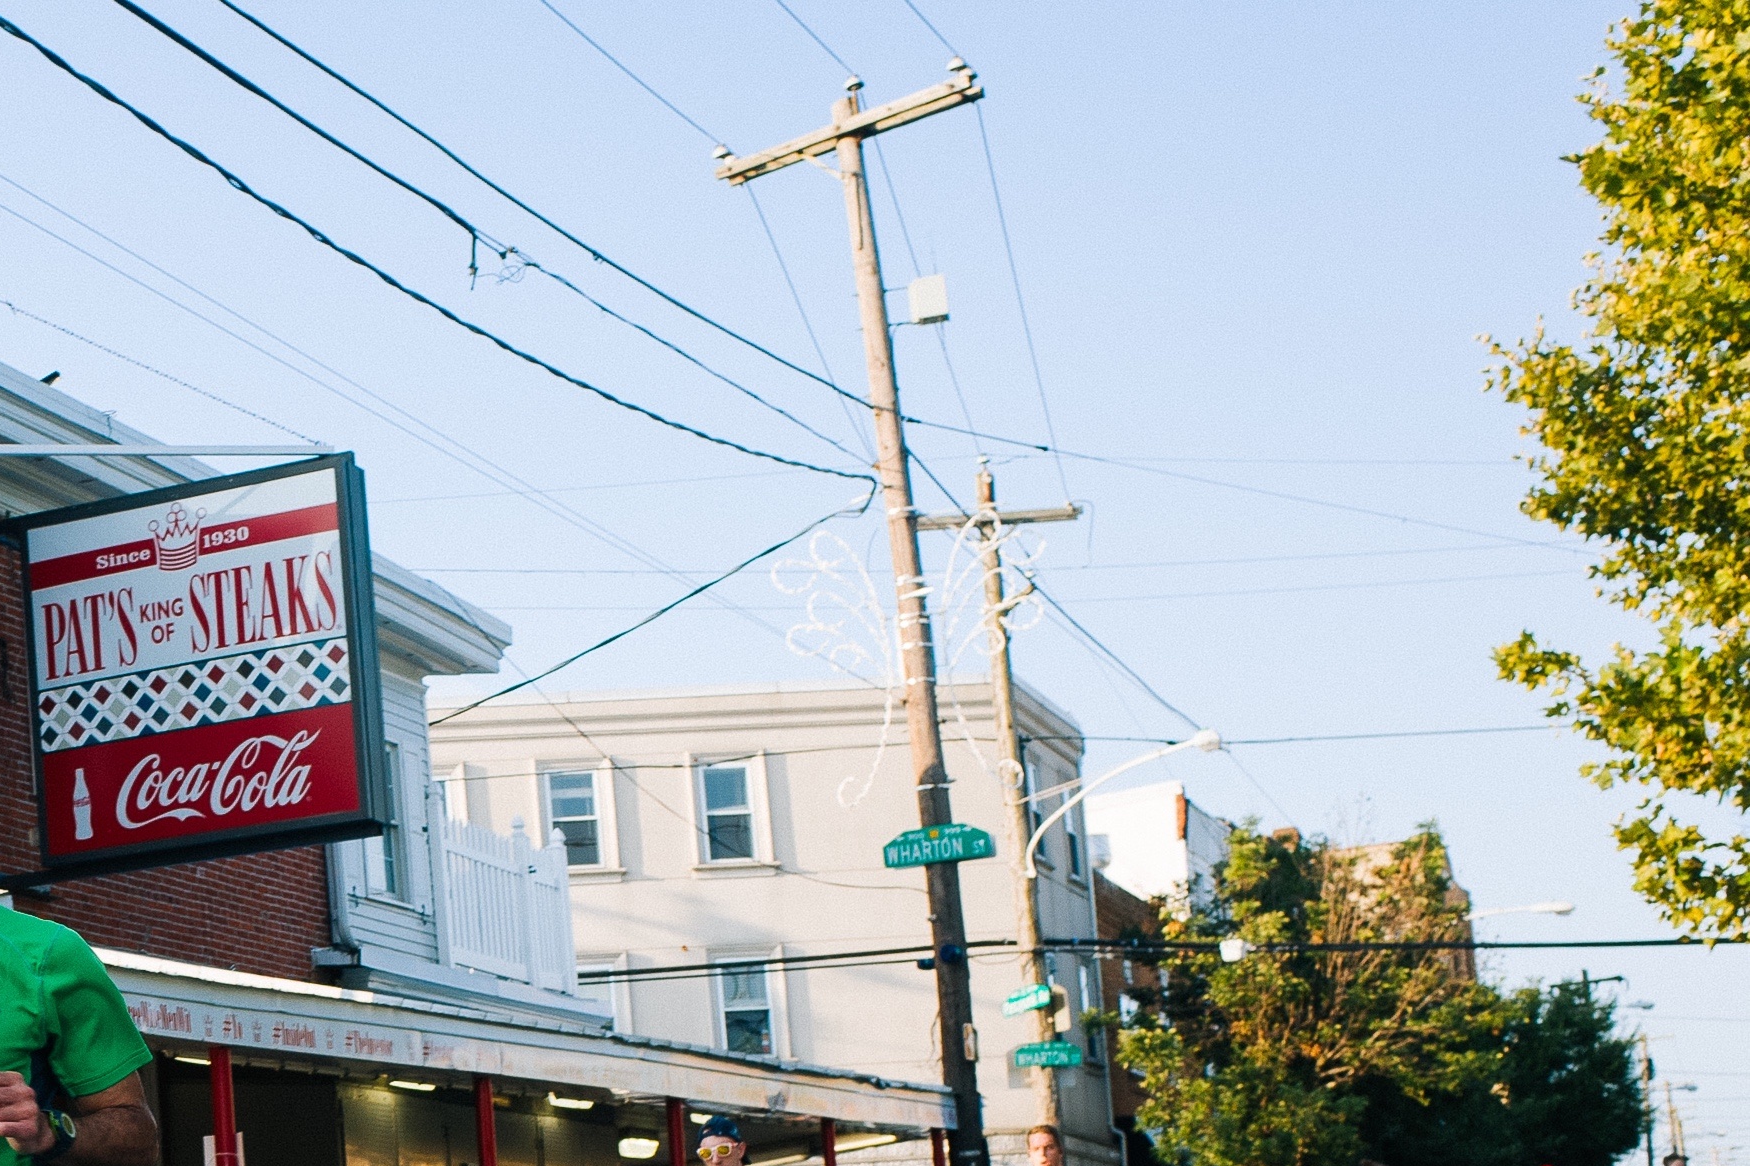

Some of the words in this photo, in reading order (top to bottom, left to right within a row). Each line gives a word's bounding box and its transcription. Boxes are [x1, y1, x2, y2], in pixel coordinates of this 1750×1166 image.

[96, 548, 151, 570] Since
[203, 526, 249, 549] 1930
[42, 587, 138, 682] PAT'S
[140, 598, 185, 623] KING
[189, 551, 338, 655] STEAKS
[151, 623, 175, 645] OF
[116, 728, 322, 829] Coca-Cola
[887, 836, 964, 866] WHARTON
